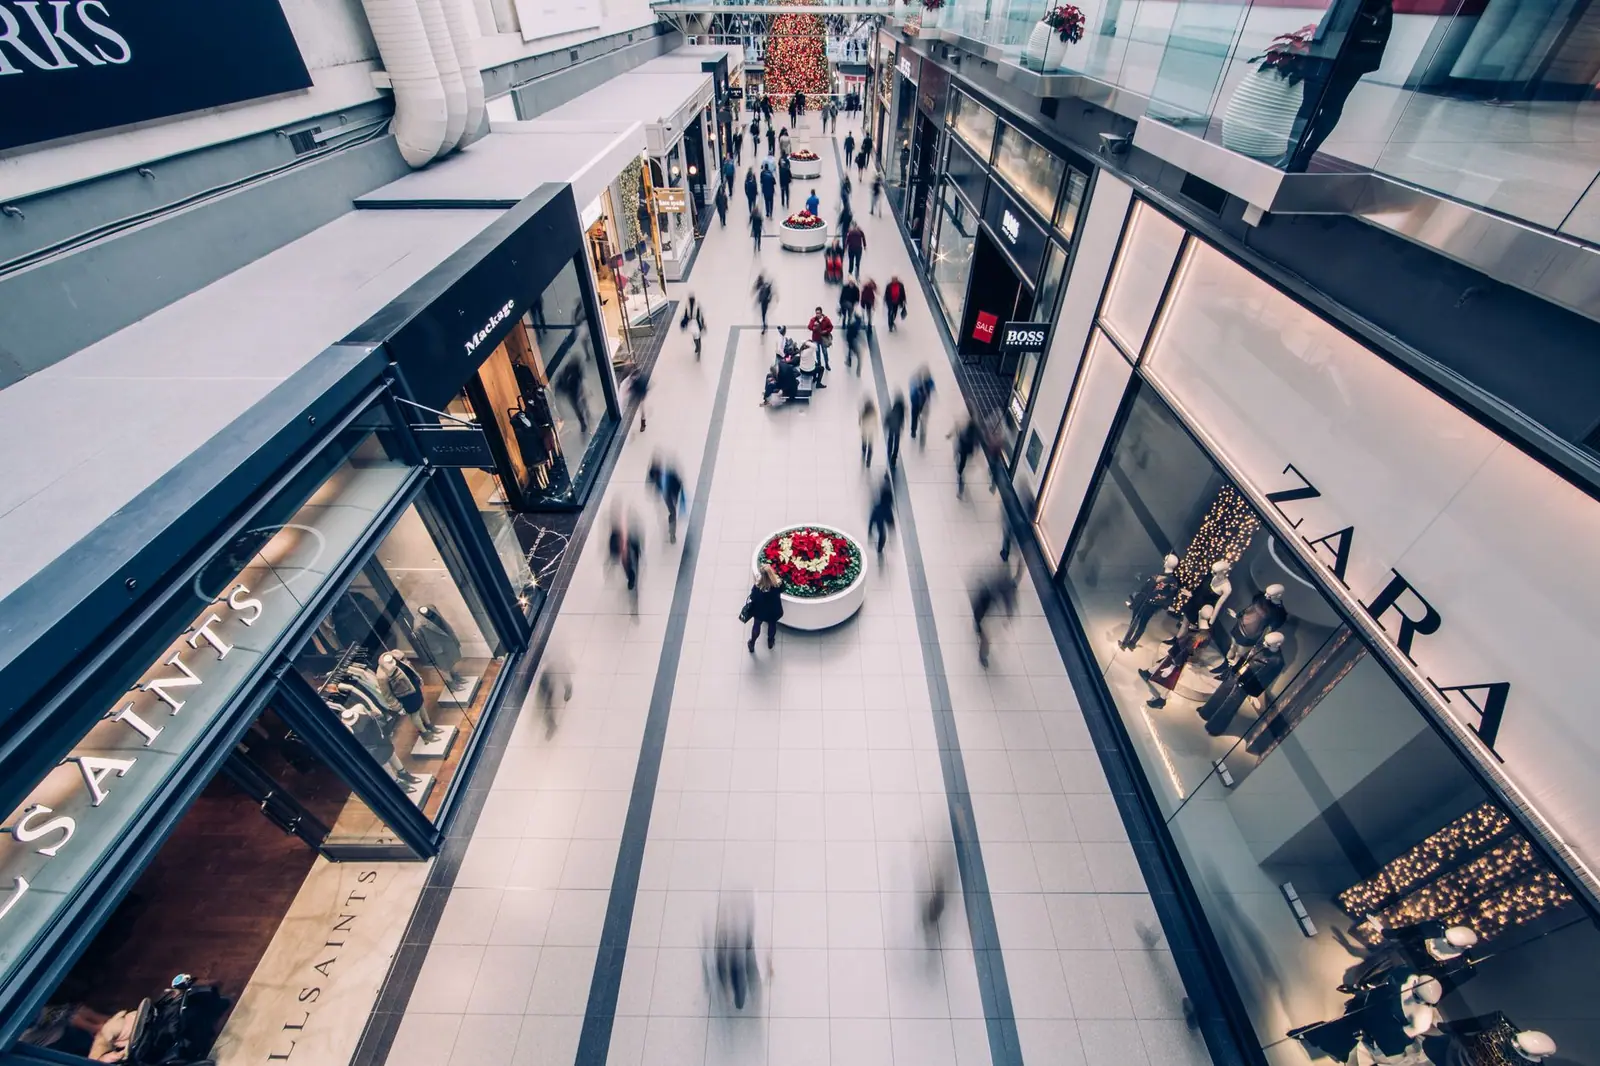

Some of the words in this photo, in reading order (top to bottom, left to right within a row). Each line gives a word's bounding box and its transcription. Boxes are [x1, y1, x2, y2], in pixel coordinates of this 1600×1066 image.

[0, 0, 131, 75] RKS
[464, 299, 515, 356] Mackage
[975, 321, 995, 334] SALE
[1006, 330, 1044, 342] BOSS
[1265, 463, 1511, 764] ZARA
[267, 870, 378, 1062] LLSAINTS
